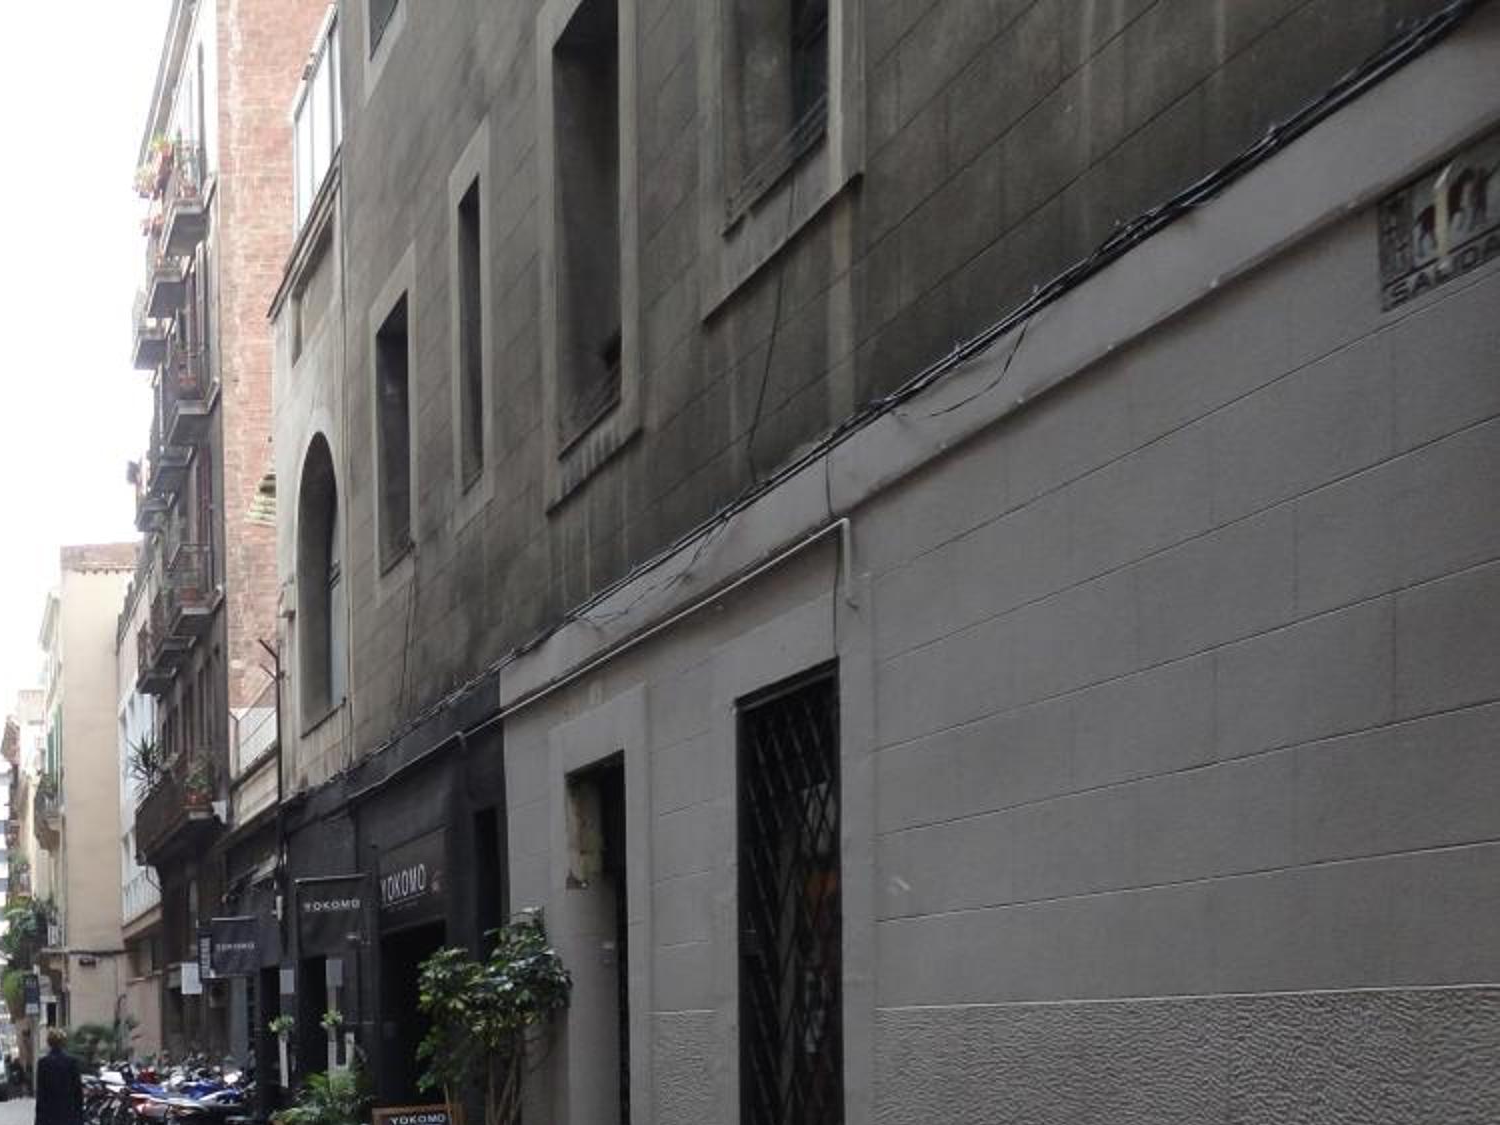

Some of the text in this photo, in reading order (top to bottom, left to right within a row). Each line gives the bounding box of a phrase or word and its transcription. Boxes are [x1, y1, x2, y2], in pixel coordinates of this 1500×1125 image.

[380, 863, 427, 905] YOKOMO
[303, 898, 361, 912] YOKOMO
[390, 1113, 447, 1125] YOKOMO
